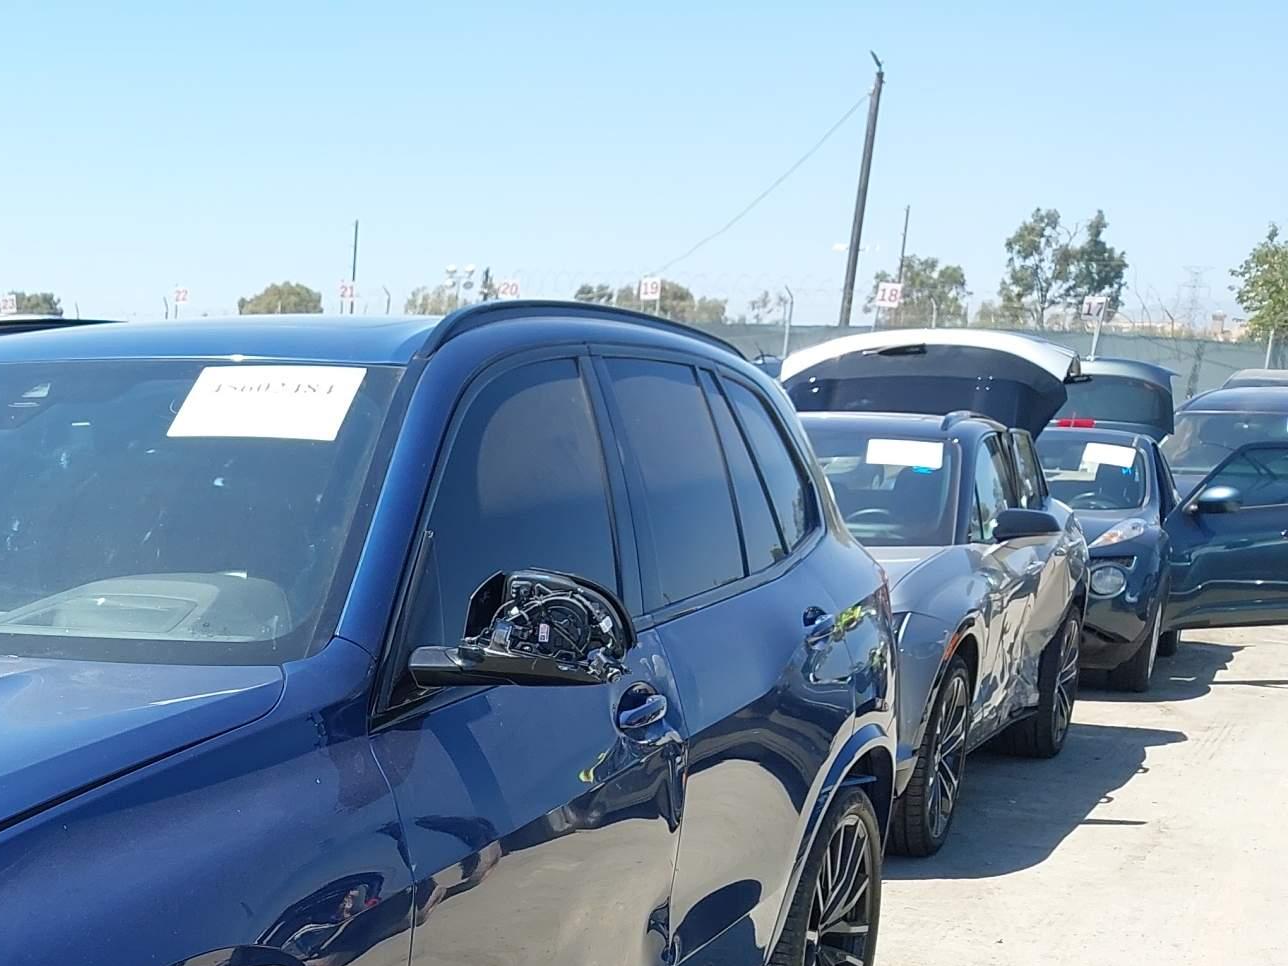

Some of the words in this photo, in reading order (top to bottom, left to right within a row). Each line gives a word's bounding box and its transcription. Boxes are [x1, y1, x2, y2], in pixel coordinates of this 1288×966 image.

[340, 285, 354, 298] 21
[501, 282, 519, 296] 20
[642, 281, 659, 295] 19
[880, 287, 899, 302] 18
[175, 289, 188, 302] 22
[1083, 302, 1104, 316] 17
